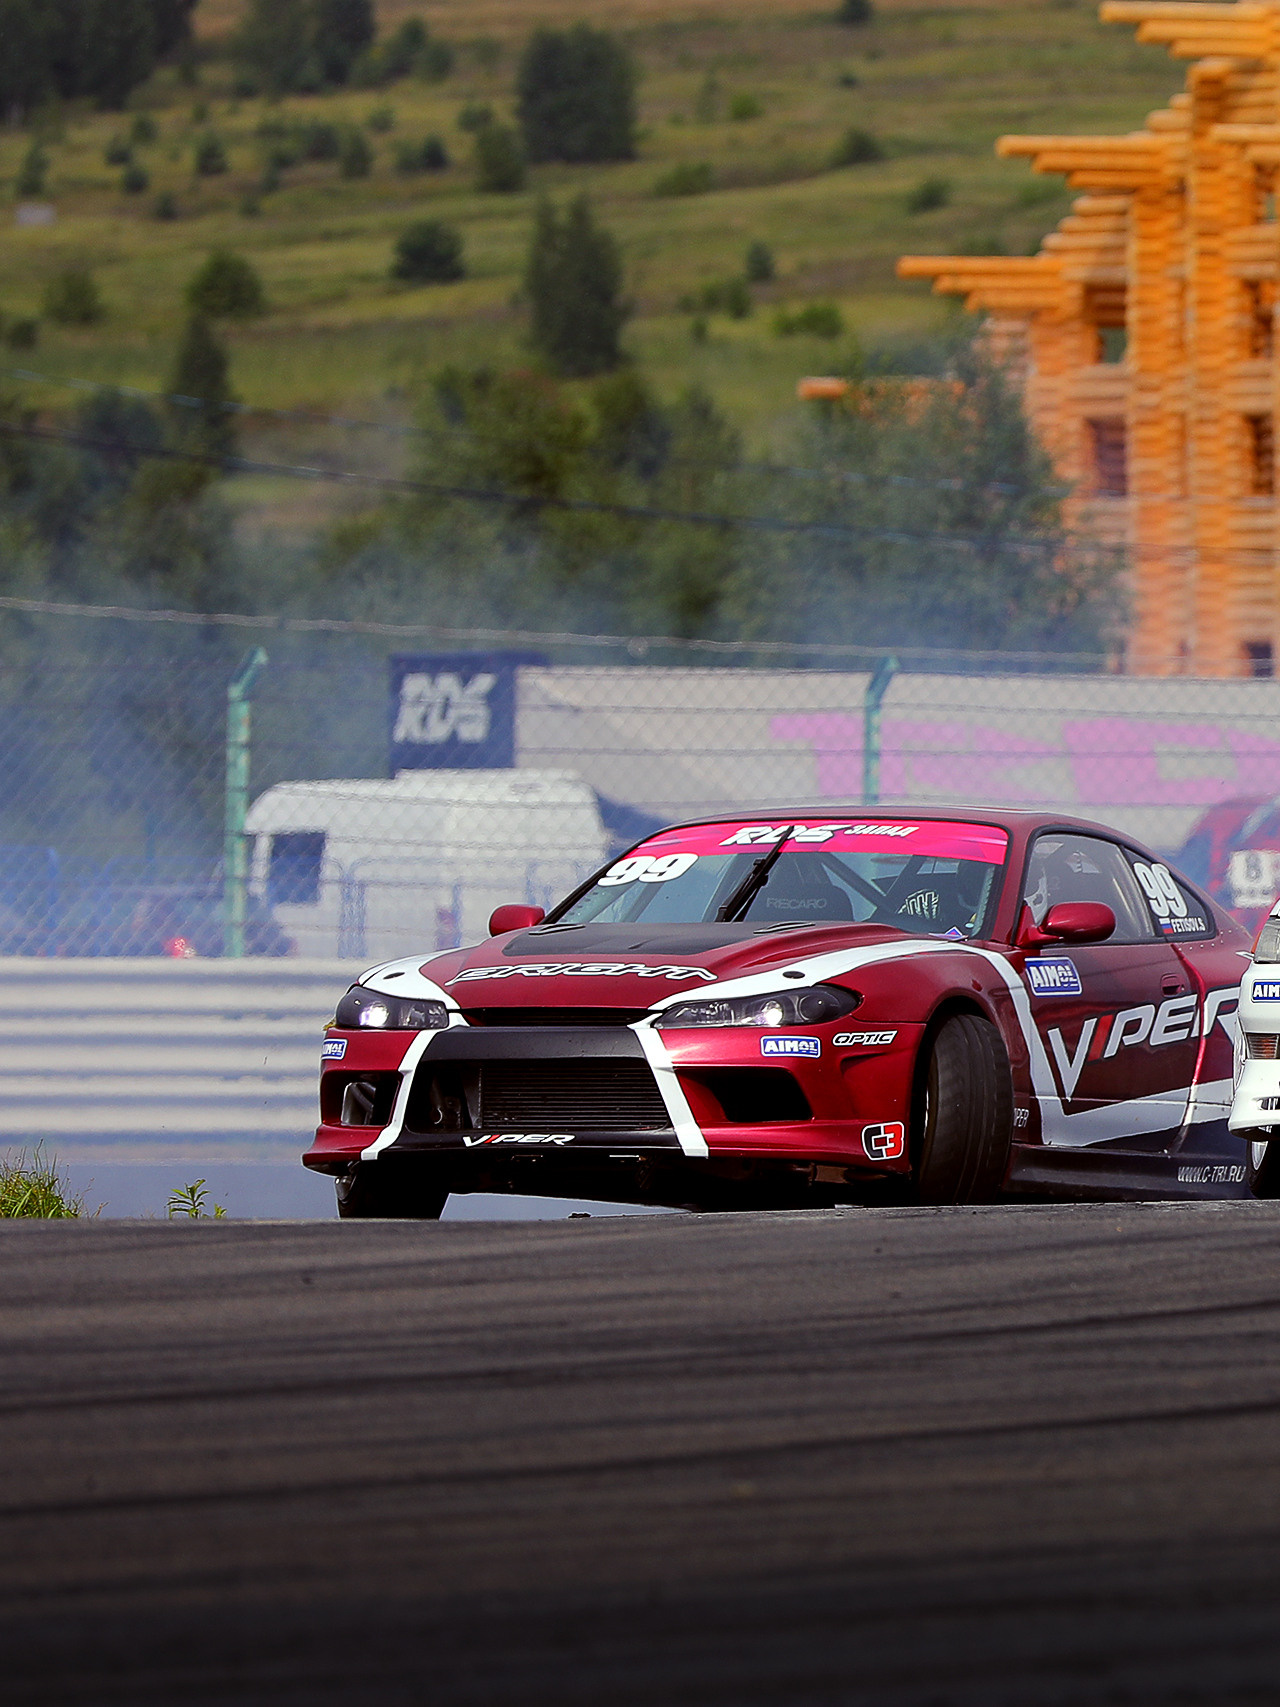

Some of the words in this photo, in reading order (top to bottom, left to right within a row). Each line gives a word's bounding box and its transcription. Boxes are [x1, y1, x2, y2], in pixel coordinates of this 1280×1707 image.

[719, 824, 852, 846] RDS
[597, 853, 699, 886] 99
[1133, 861, 1189, 917] 99
[1032, 964, 1078, 987] AIMOL
[764, 1040, 818, 1054] AIMOL
[833, 1031, 897, 1046] OPTIC
[1048, 986, 1239, 1102] VIPER
[463, 1134, 576, 1147] VIPER
